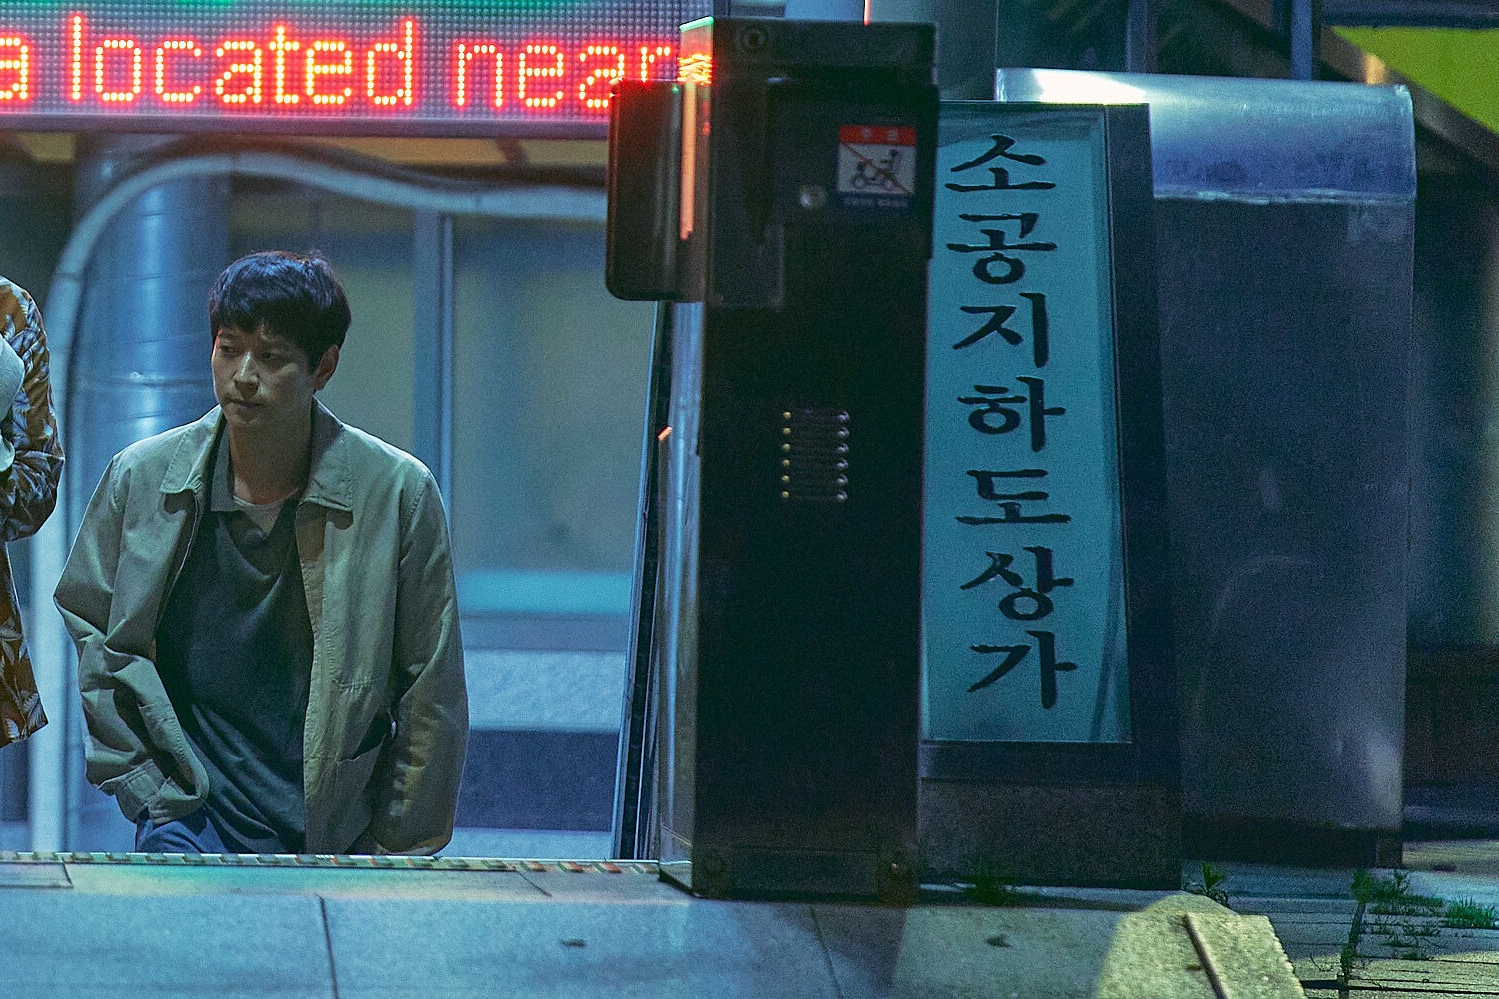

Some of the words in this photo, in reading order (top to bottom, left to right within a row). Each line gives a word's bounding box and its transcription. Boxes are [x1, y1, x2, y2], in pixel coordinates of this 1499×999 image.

[68, 13, 415, 107] located
[457, 42, 673, 109] near
[945, 133, 1078, 710] 소공지하도상가
